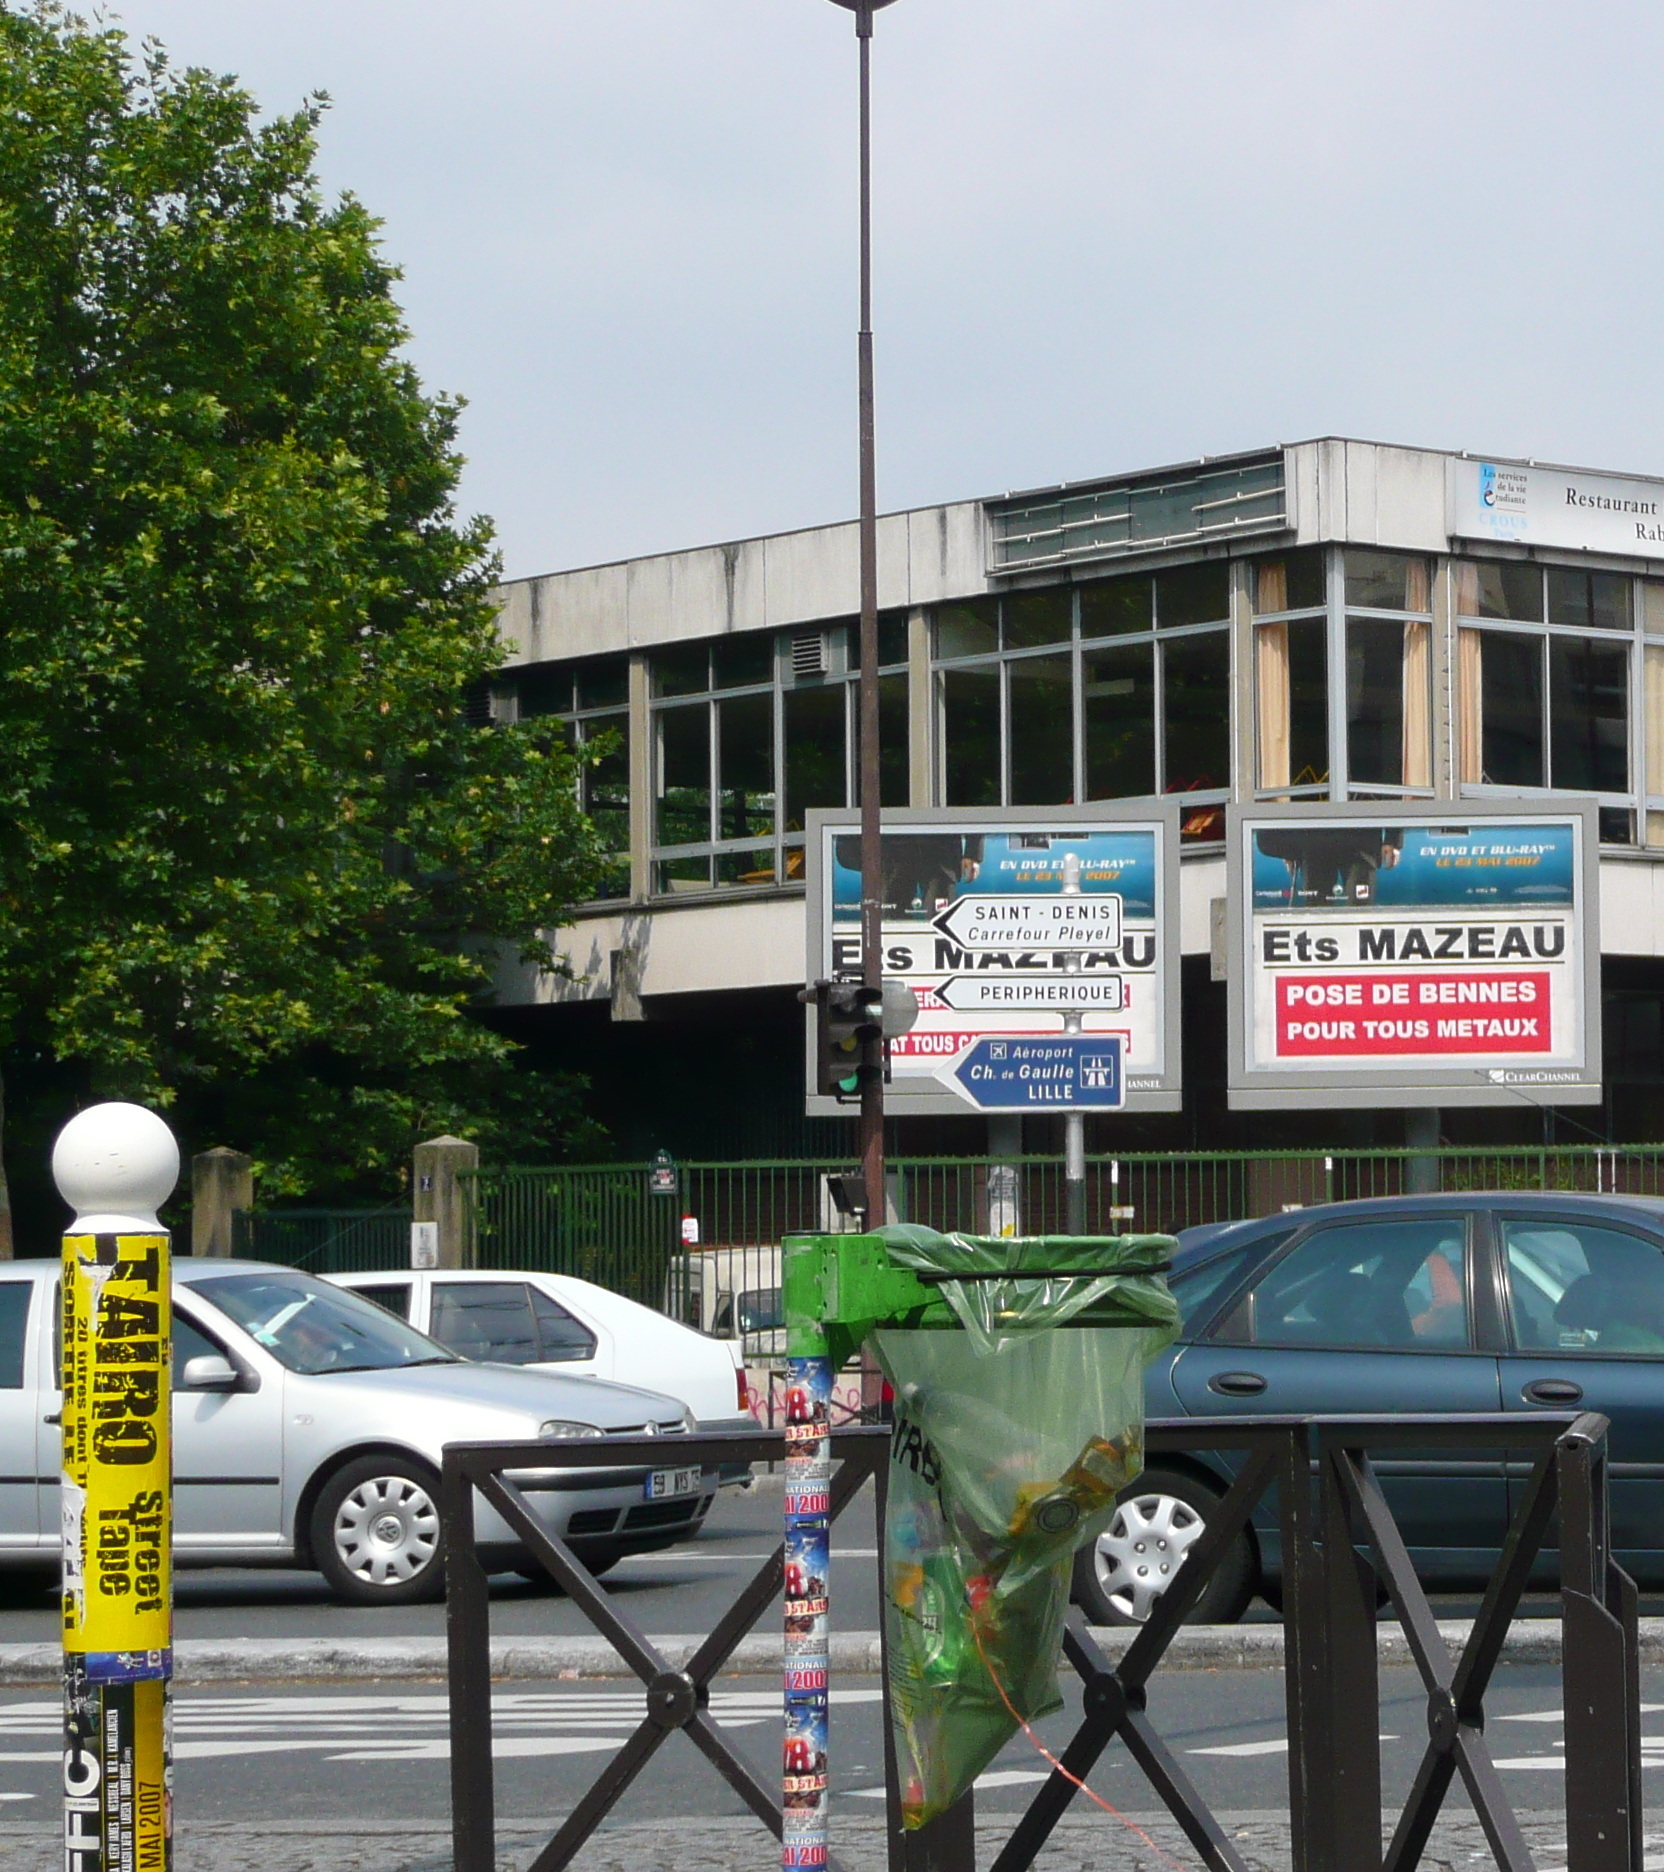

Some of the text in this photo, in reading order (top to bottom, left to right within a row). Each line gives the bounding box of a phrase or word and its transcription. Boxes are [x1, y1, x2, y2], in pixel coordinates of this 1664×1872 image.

[1565, 487, 1658, 516] Restaurant
[1420, 845, 1437, 857] EN
[1441, 845, 1467, 857] DVD
[1471, 845, 1487, 856] ET
[1504, 856, 1541, 867] 2007
[999, 860, 1017, 870] EN
[1021, 860, 1047, 870] DVD
[975, 905, 1031, 921] SAINT
[1052, 904, 1111, 920] DENIS
[968, 925, 1111, 943] Carrefour Pleyel
[1262, 925, 1566, 962] Ets MAZEAU
[832, 939, 914, 970] Es
[980, 985, 1113, 1001] PERIPHERIQUE
[1286, 981, 1537, 1006] POSE DE BENNES
[1287, 1018, 1539, 1041] POUR TOUS METAUX
[912, 1036, 955, 1053] TOUS
[1012, 1045, 1073, 1060] Aéroport
[1001, 1068, 1015, 1079] de
[1019, 1064, 1075, 1079] Gaulle
[1028, 1084, 1073, 1100] LILLE
[63, 1260, 76, 1406] SORTIE
[77, 1317, 89, 1343] 20
[93, 1246, 160, 1466] TAIRO
[77, 1416, 89, 1463] dont
[96, 1502, 137, 1597] Tape
[134, 1490, 164, 1616] Street
[138, 1781, 162, 1869] MAI 2007
